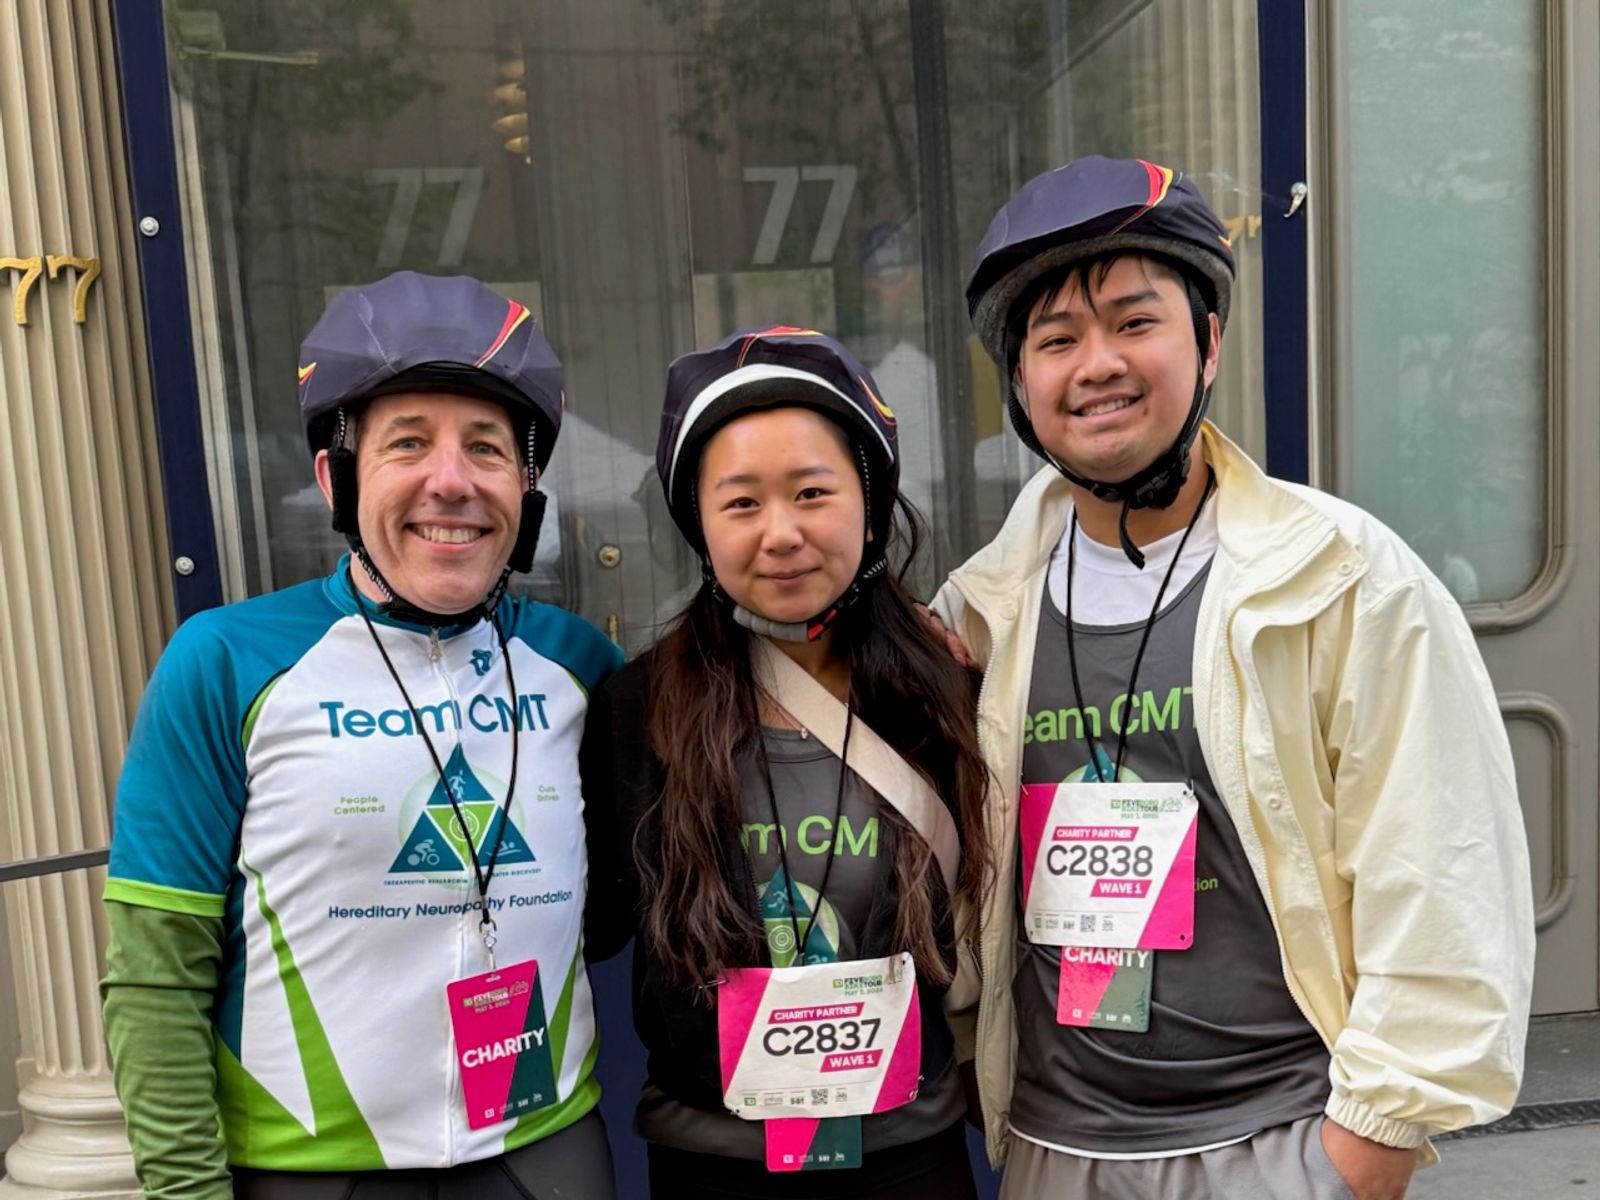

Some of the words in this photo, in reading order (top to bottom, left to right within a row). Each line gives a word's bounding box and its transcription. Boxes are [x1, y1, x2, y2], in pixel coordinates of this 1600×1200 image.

[365, 167, 484, 268] 77
[742, 164, 858, 265] 77
[0, 254, 101, 326] 77
[319, 699, 462, 738] Team
[469, 693, 550, 733] CMT
[333, 804, 385, 815] Centered
[340, 794, 379, 805] People
[797, 815, 879, 857] CM
[1056, 828, 1091, 838] CHARITY
[1092, 828, 1133, 838] PARTNER
[1047, 844, 1153, 877] C2838
[1099, 883, 1133, 894] WAVE
[1134, 883, 1142, 894] 1
[328, 905, 411, 919] Hereditary
[415, 897, 506, 916] Neuropahy
[509, 890, 573, 908] Foundation
[1064, 946, 1150, 969] CHARITY
[774, 1009, 815, 1020] CHARITY
[816, 1005, 858, 1018] PARTNER
[462, 1027, 546, 1068] CHARITY
[763, 1018, 881, 1056] C2837
[829, 1055, 865, 1068] WAVE
[866, 1053, 875, 1064] 1
